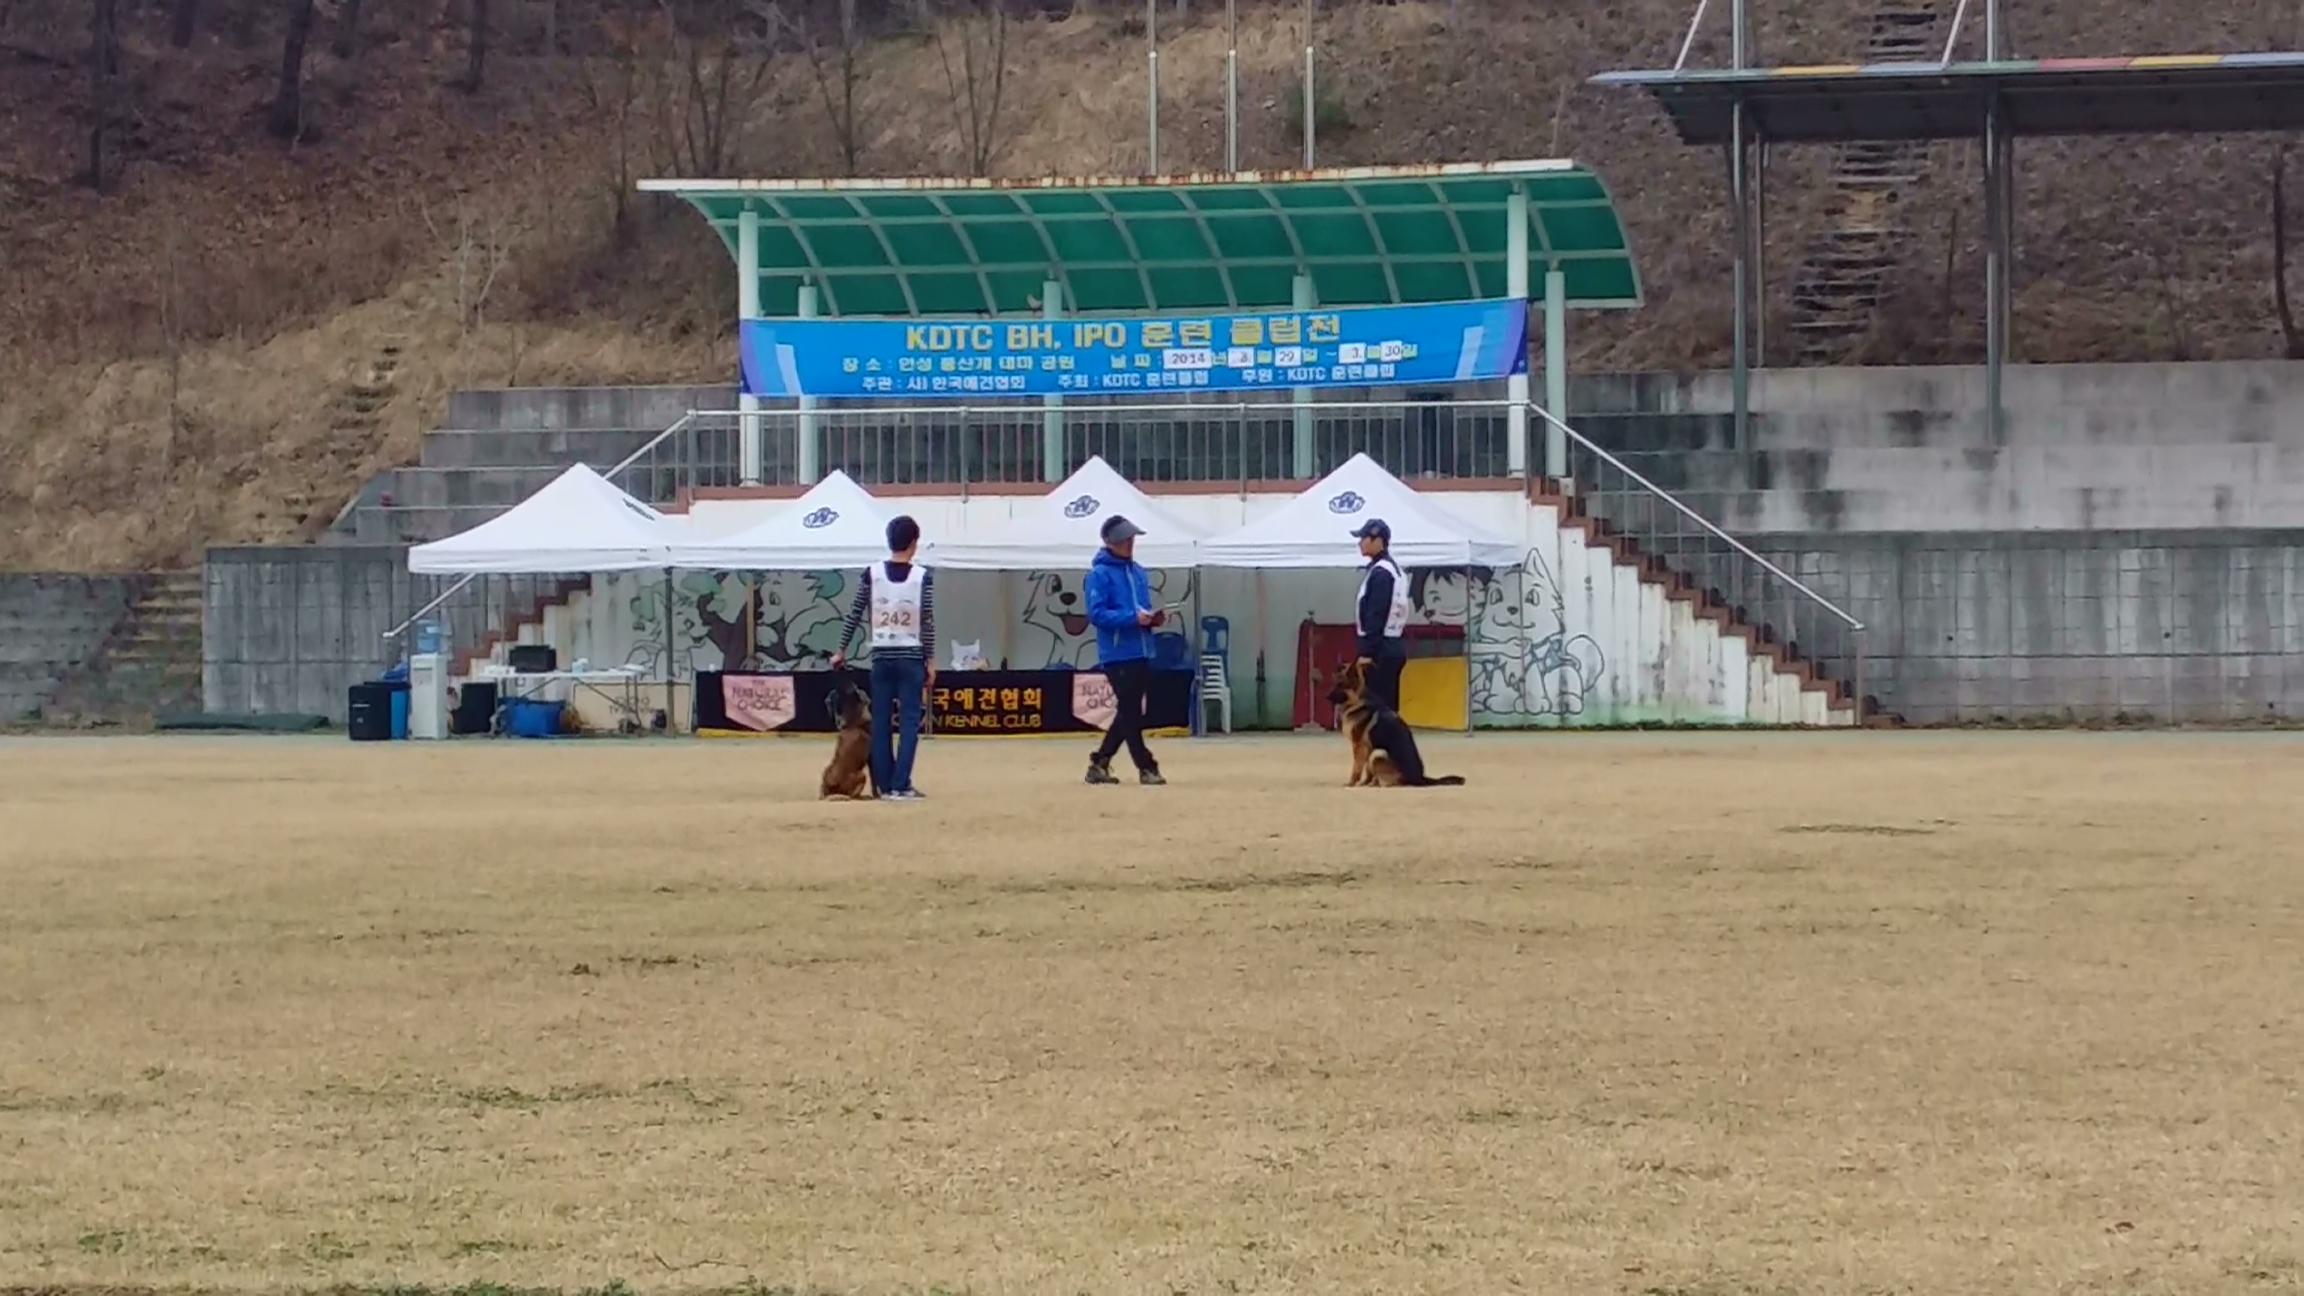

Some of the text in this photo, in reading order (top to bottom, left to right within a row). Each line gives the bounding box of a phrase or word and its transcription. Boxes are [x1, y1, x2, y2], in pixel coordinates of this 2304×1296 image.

[906, 324, 993, 351] KDTC
[1074, 322, 1126, 348] IPO
[1172, 353, 1206, 365] 2014
[1384, 345, 1400, 357] 30
[1102, 373, 1141, 388] KDTC
[1287, 367, 1326, 381] KDTC
[881, 611, 911, 626] 242
[945, 713, 1001, 728] KENNEL
